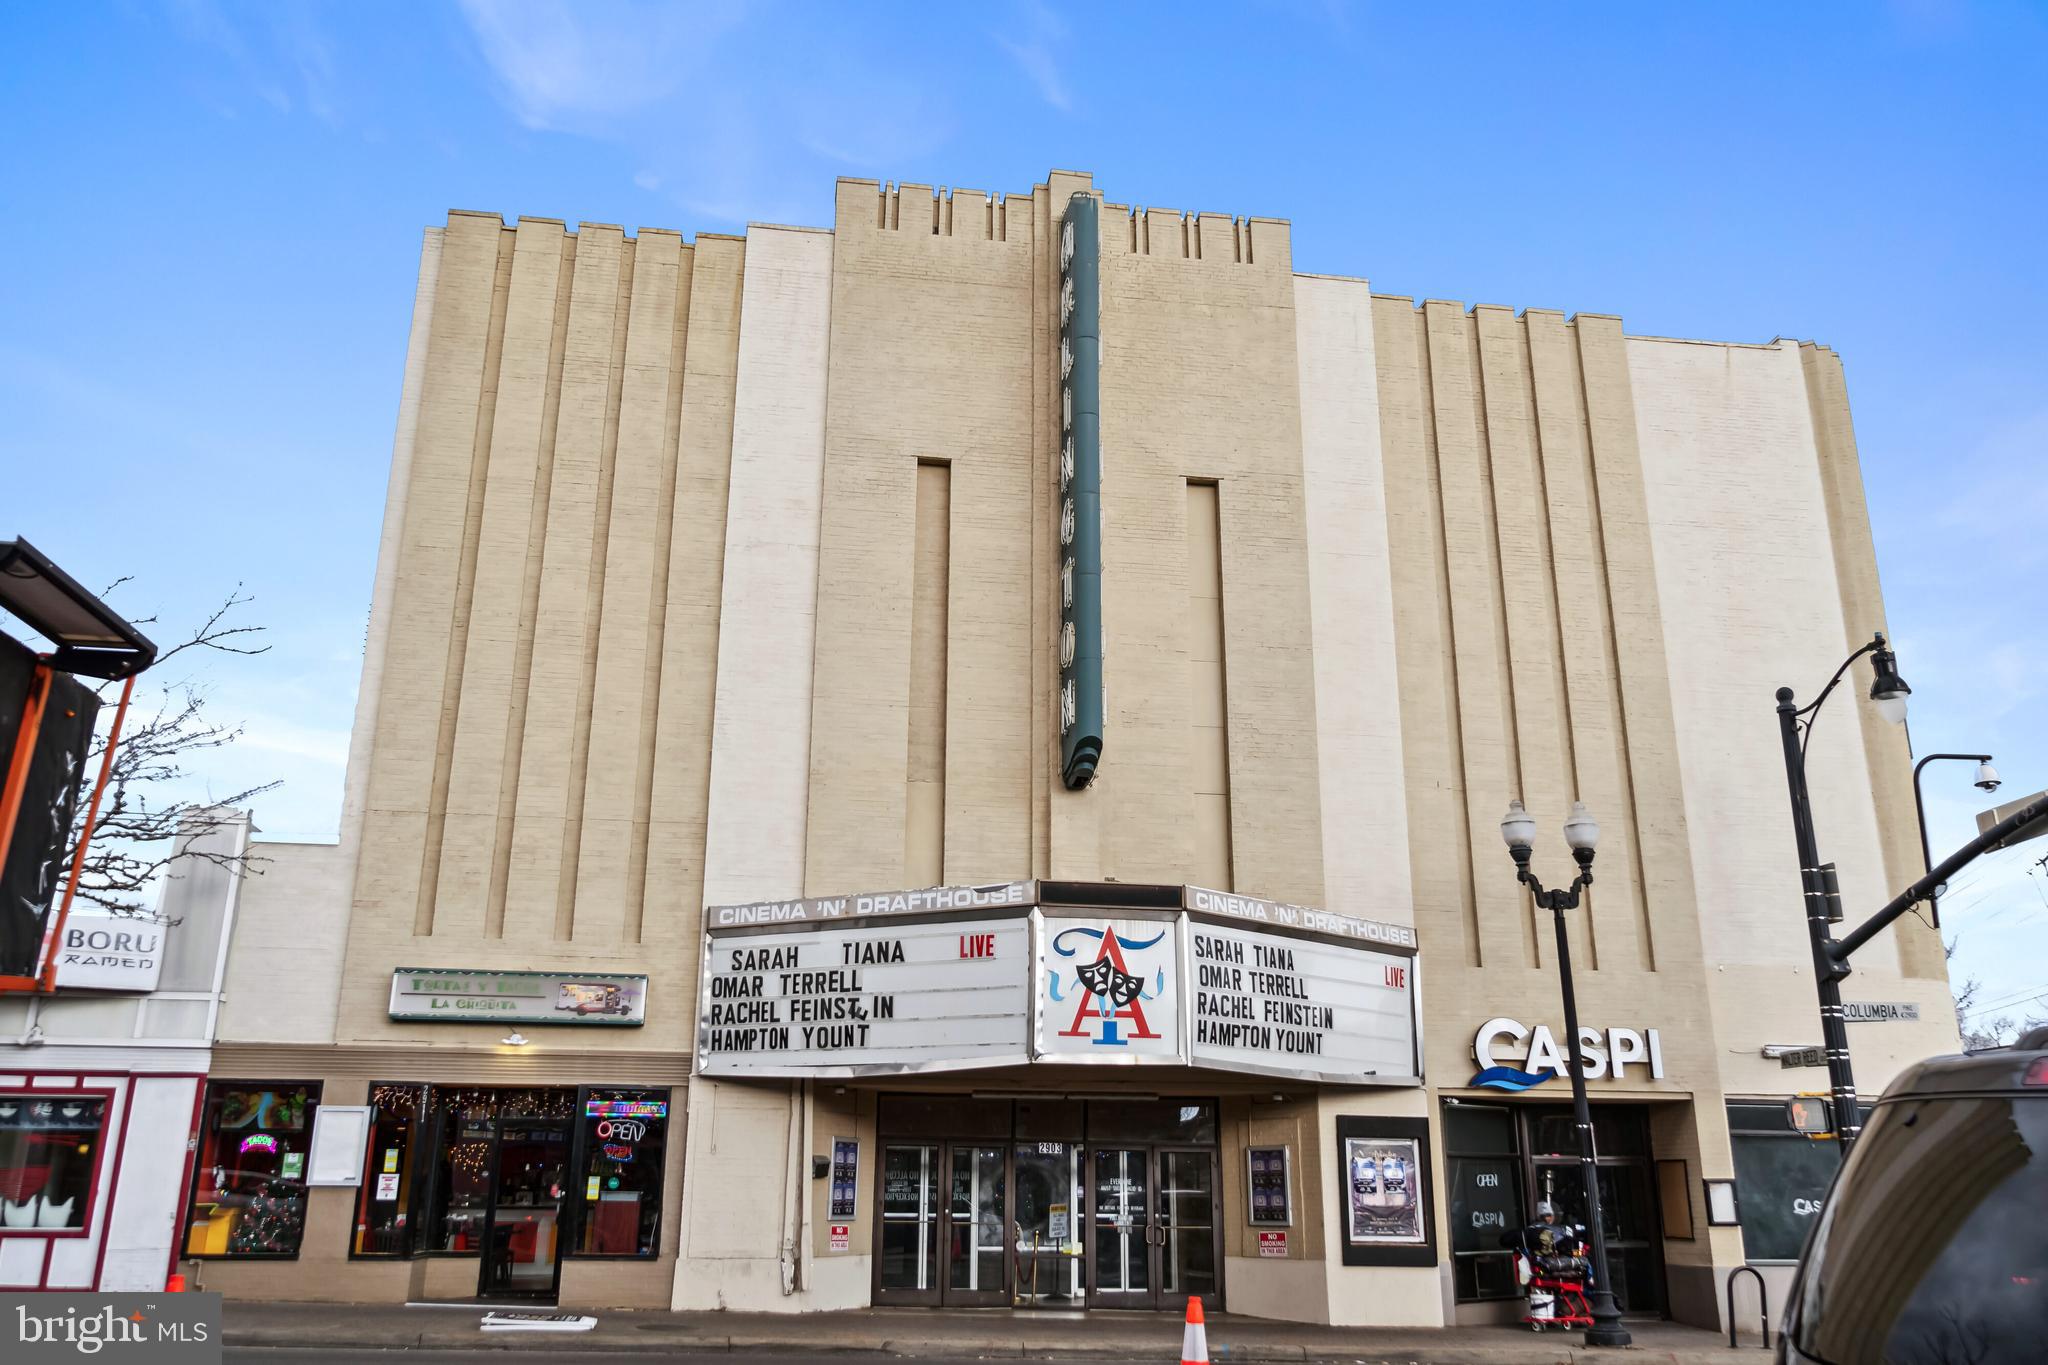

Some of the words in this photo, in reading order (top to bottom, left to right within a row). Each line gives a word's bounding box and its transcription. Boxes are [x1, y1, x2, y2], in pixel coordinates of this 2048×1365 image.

[719, 904, 806, 924] CINEMA
[816, 899, 846, 918] 'N'
[857, 885, 1024, 914] DRAFTHOUSE
[1195, 892, 1267, 920] CINEMA
[1274, 907, 1298, 924] 'N'
[1303, 911, 1410, 944] DRAFTHOUSE
[66, 929, 158, 953] BORU
[959, 934, 995, 958] LIVE
[1195, 935, 1244, 964] SARAH
[1253, 945, 1294, 971] TIANA
[64, 954, 153, 968] RAMEN
[731, 946, 799, 971] SARAH
[842, 940, 905, 964] TIANA
[711, 975, 763, 998] OMAR
[780, 970, 862, 996] TERRELL
[1199, 965, 1242, 990] OMAR
[1248, 971, 1308, 999] TERRELL
[1384, 965, 1405, 988] LIVE
[711, 1002, 780, 1025] RACHEL
[1197, 992, 1255, 1020] RACHEL
[1264, 999, 1333, 1030] FEINSTEIN
[1842, 1004, 1898, 1018] COLUMBIA
[711, 1027, 789, 1050] HAMPTON
[802, 1024, 869, 1049] YOUNT
[1197, 1020, 1271, 1050] HAMPTON
[1276, 1029, 1322, 1054] YOUNT
[1475, 1018, 1664, 1080] CASPI
[598, 1120, 646, 1142] OPEN
[1039, 1143, 1062, 1153] 2903
[1477, 1174, 1498, 1187] OPEN
[1472, 1212, 1498, 1226] CASPI
